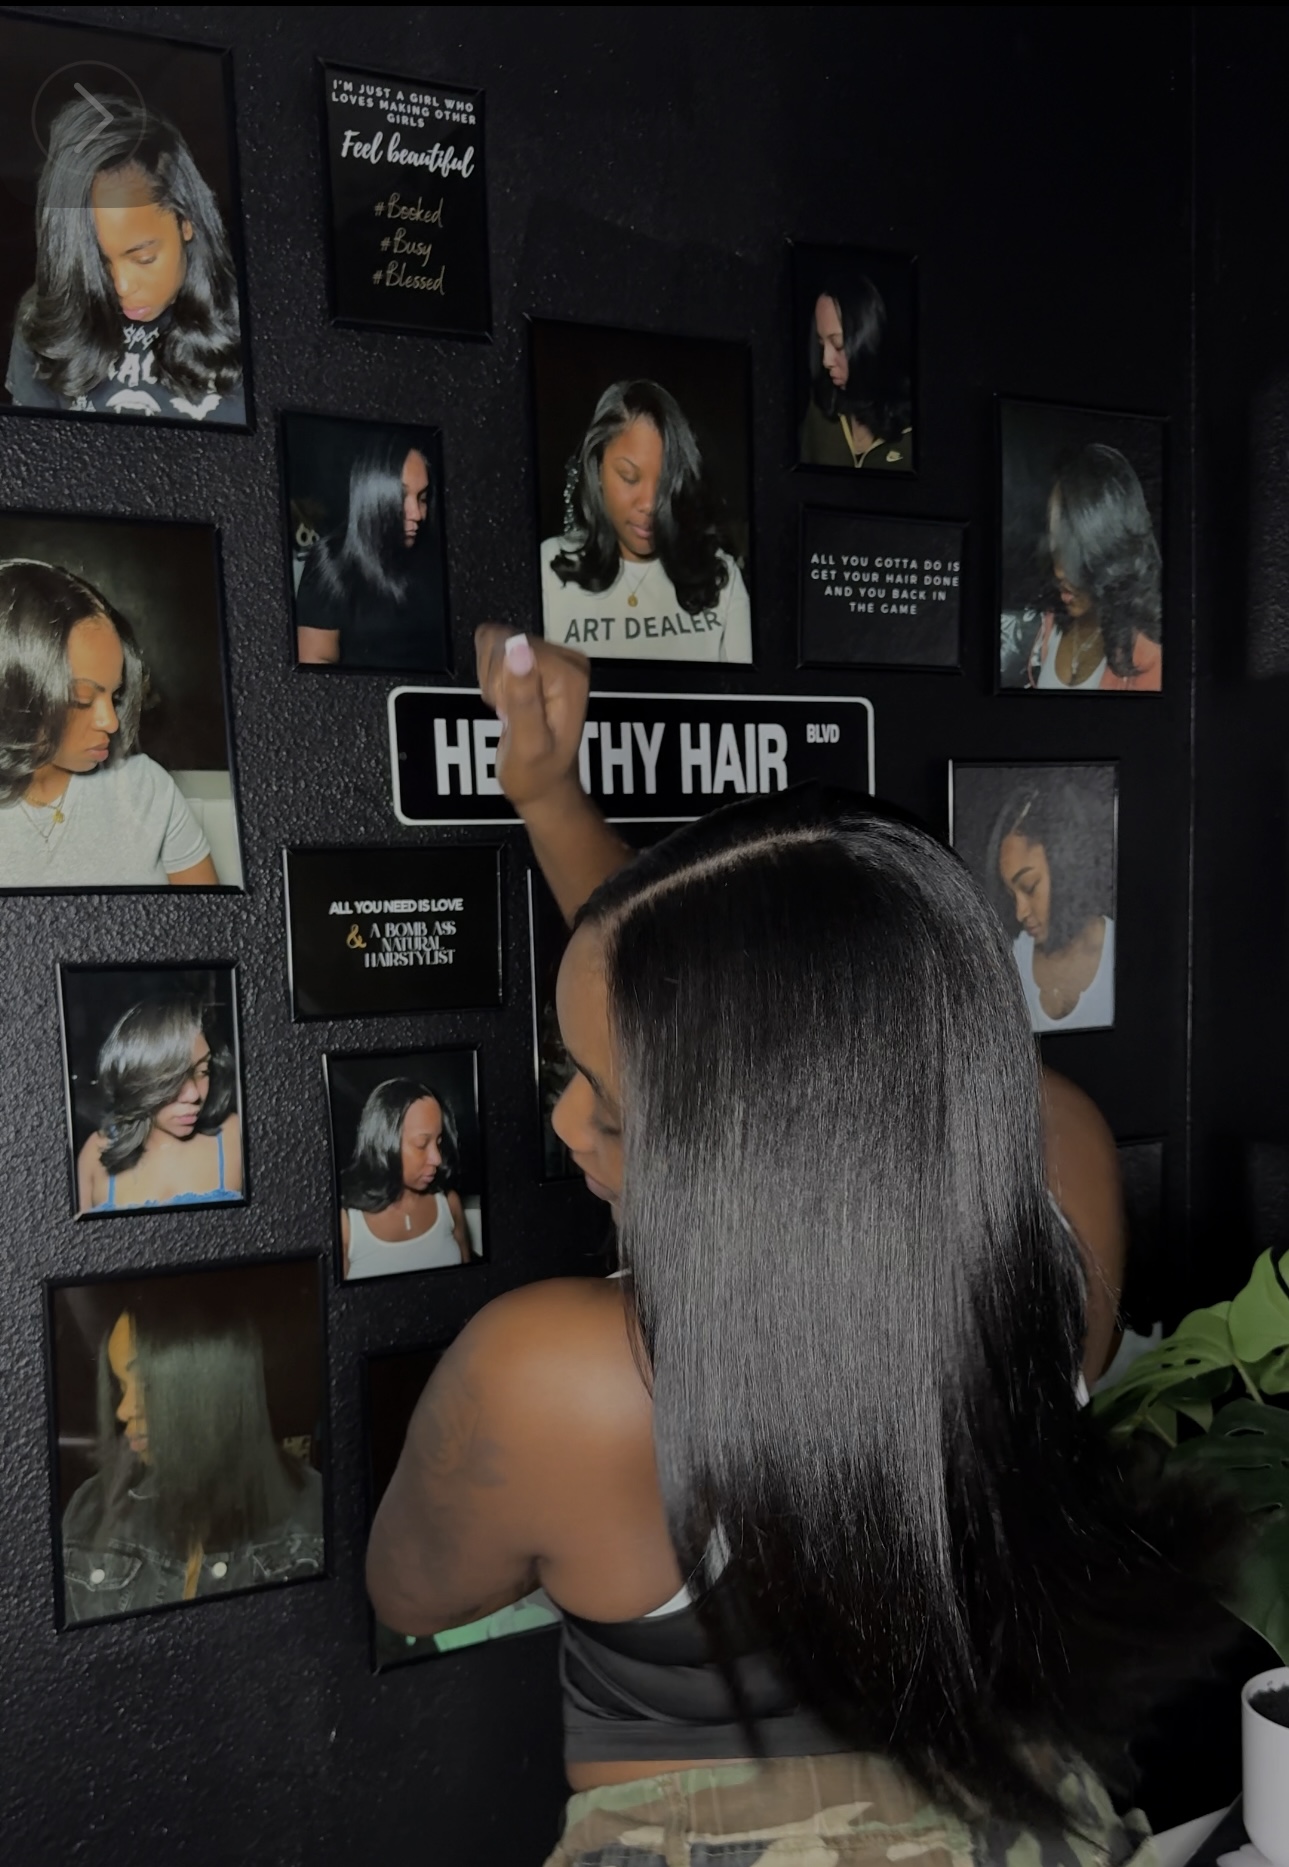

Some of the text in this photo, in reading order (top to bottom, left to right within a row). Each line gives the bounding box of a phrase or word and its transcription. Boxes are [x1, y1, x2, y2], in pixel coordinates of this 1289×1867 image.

[331, 91, 476, 125] LOVES MAKING OTHER
[333, 79, 474, 113] I'M JUST A GIRL WHO
[386, 112, 425, 128] GIRLS
[340, 129, 475, 179] Feel beautiful
[374, 192, 444, 228] #Booked
[380, 227, 432, 268] #Busy
[372, 260, 445, 296] #Blessed
[810, 552, 960, 572] ALL YOU GOTTA DO IS
[810, 569, 960, 587] GET YOUR HAIR DONE
[824, 585, 947, 601] AND YOU BACK IN
[849, 601, 917, 615] THE GAME
[564, 608, 722, 644] ART DEALER
[434, 718, 840, 796] HETHY HAIR BLVD
[328, 898, 464, 915] ALL YOU NEED IS LOVE
[346, 919, 457, 949] & A BOMB ASS
[381, 935, 445, 952] NATURAL
[364, 948, 456, 968] HAIRSTYLIST
